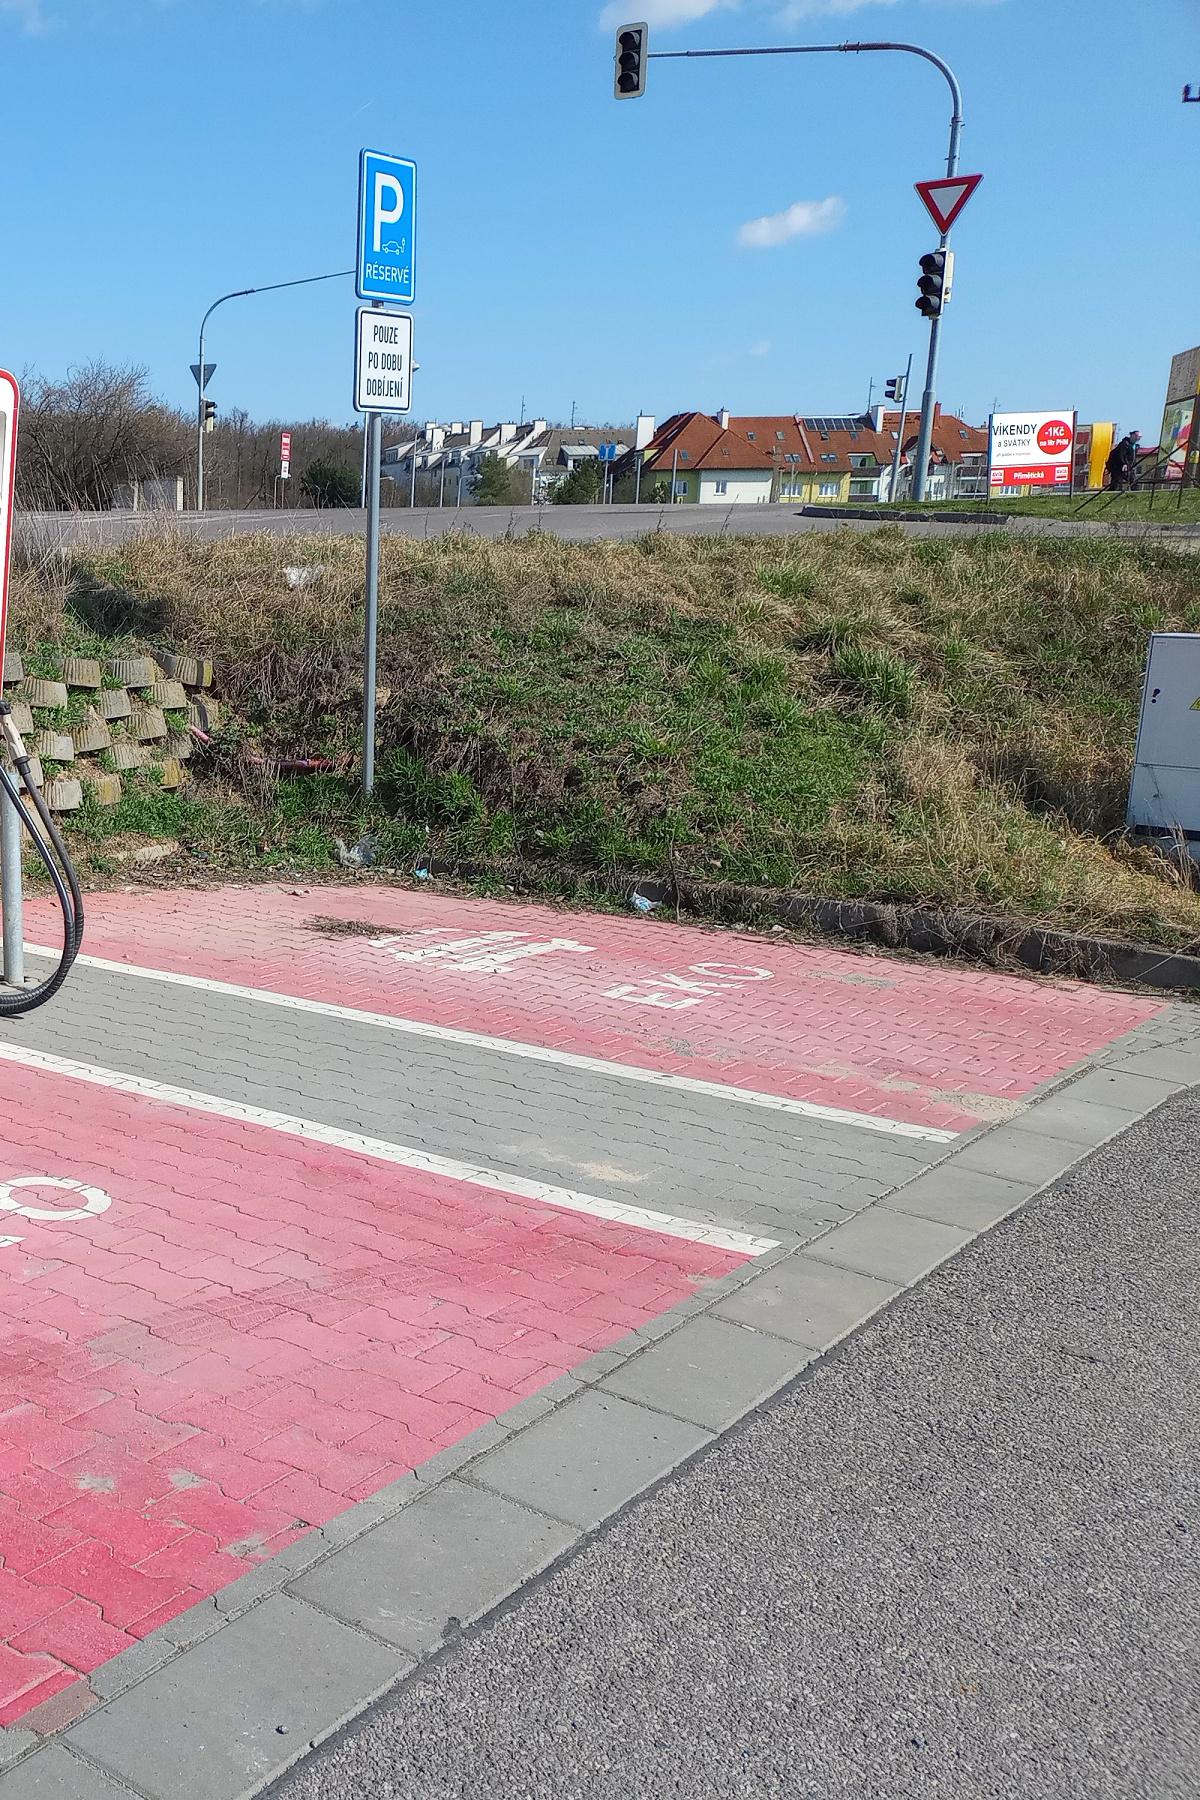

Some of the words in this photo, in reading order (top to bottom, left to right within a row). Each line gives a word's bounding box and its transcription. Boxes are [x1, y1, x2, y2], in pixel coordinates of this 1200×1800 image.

[373, 172, 404, 252] P
[365, 261, 409, 284] RÉSERVÉ
[373, 325, 398, 344] POUZE
[368, 352, 379, 369] PO
[381, 353, 402, 371] DOBU
[366, 376, 403, 398] DOBÍJENÍ
[993, 422, 1037, 436] VÍKENDY
[603, 961, 776, 1010] EKO
